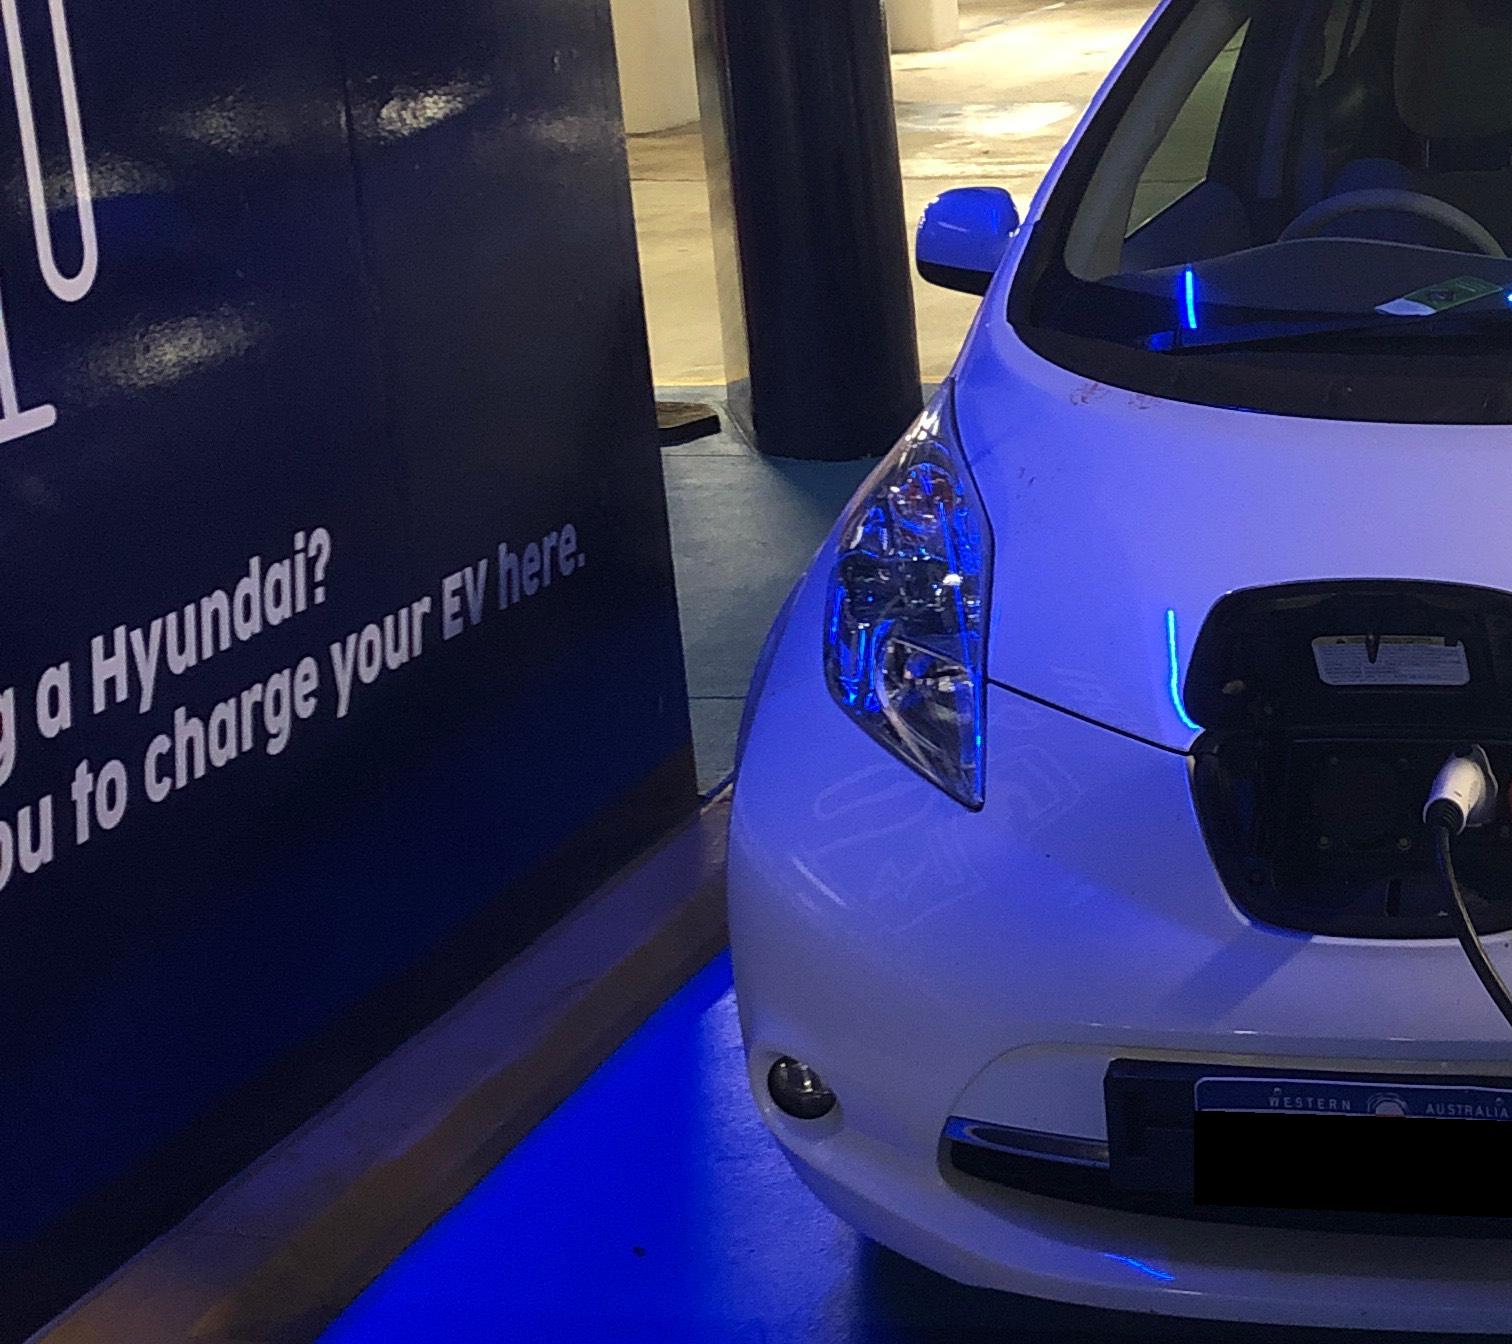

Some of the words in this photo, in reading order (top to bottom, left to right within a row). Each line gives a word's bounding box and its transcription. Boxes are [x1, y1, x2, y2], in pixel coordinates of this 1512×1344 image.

[36, 661, 72, 739] a
[90, 527, 332, 714] Hyundai?
[71, 758, 128, 845] to
[144, 656, 320, 803] charge
[329, 596, 432, 718] your
[442, 558, 488, 641] EV
[498, 523, 585, 610] here.
[1268, 1096, 1352, 1111] WESTERN
[1425, 1103, 1510, 1119] AUSTRALIA
